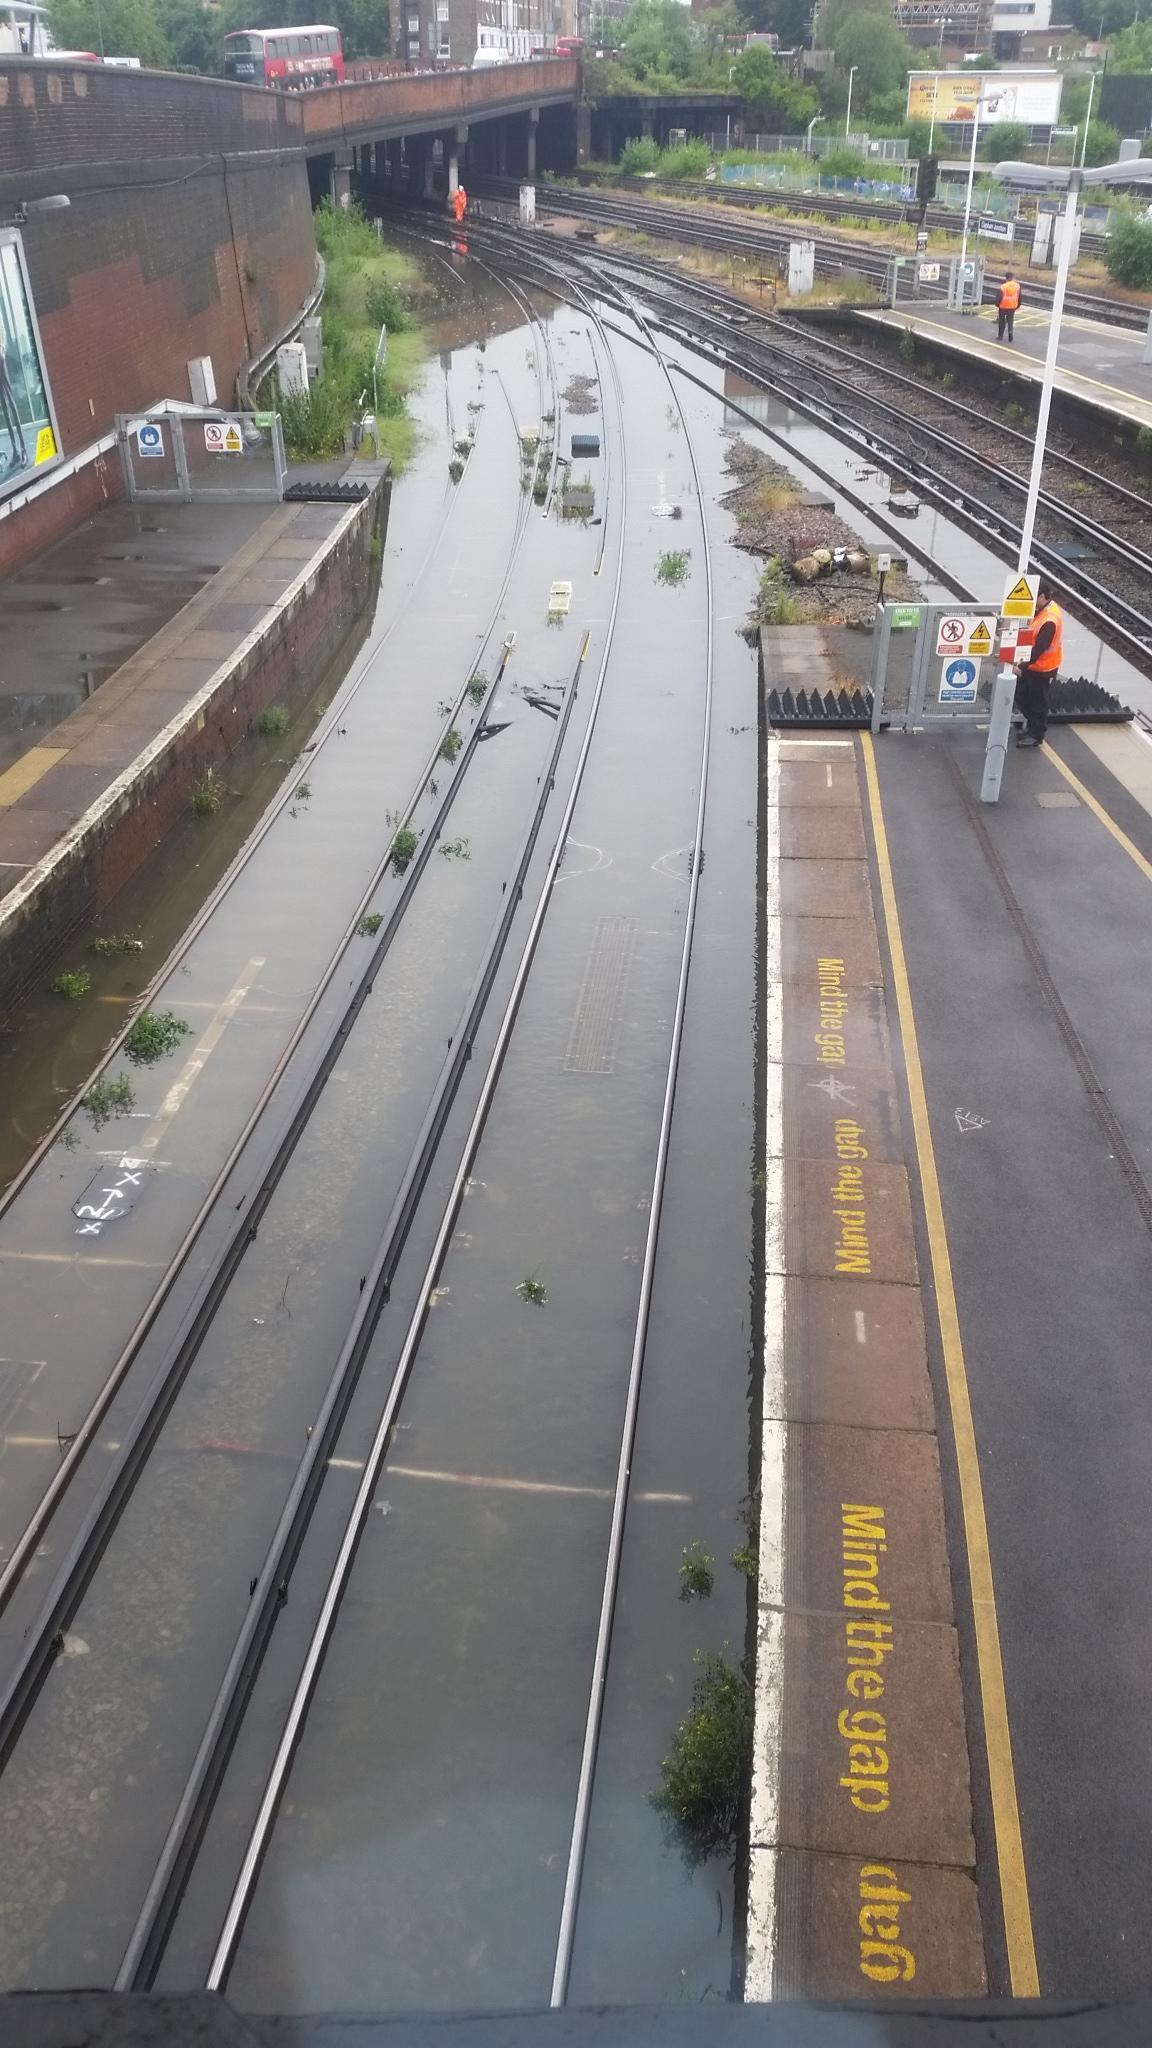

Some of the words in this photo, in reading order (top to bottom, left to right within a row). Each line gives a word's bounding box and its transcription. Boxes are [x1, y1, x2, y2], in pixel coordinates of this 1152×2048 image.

[817, 957, 848, 997] Mind
[819, 1000, 848, 1030] the
[833, 1117, 869, 1161] gap
[830, 1164, 865, 1203] the
[833, 1209, 872, 1275] Mind
[841, 1503, 892, 1611] Mind
[846, 1620, 895, 1700] the
[838, 1708, 892, 1815] gap
[859, 1864, 917, 1984] gap
